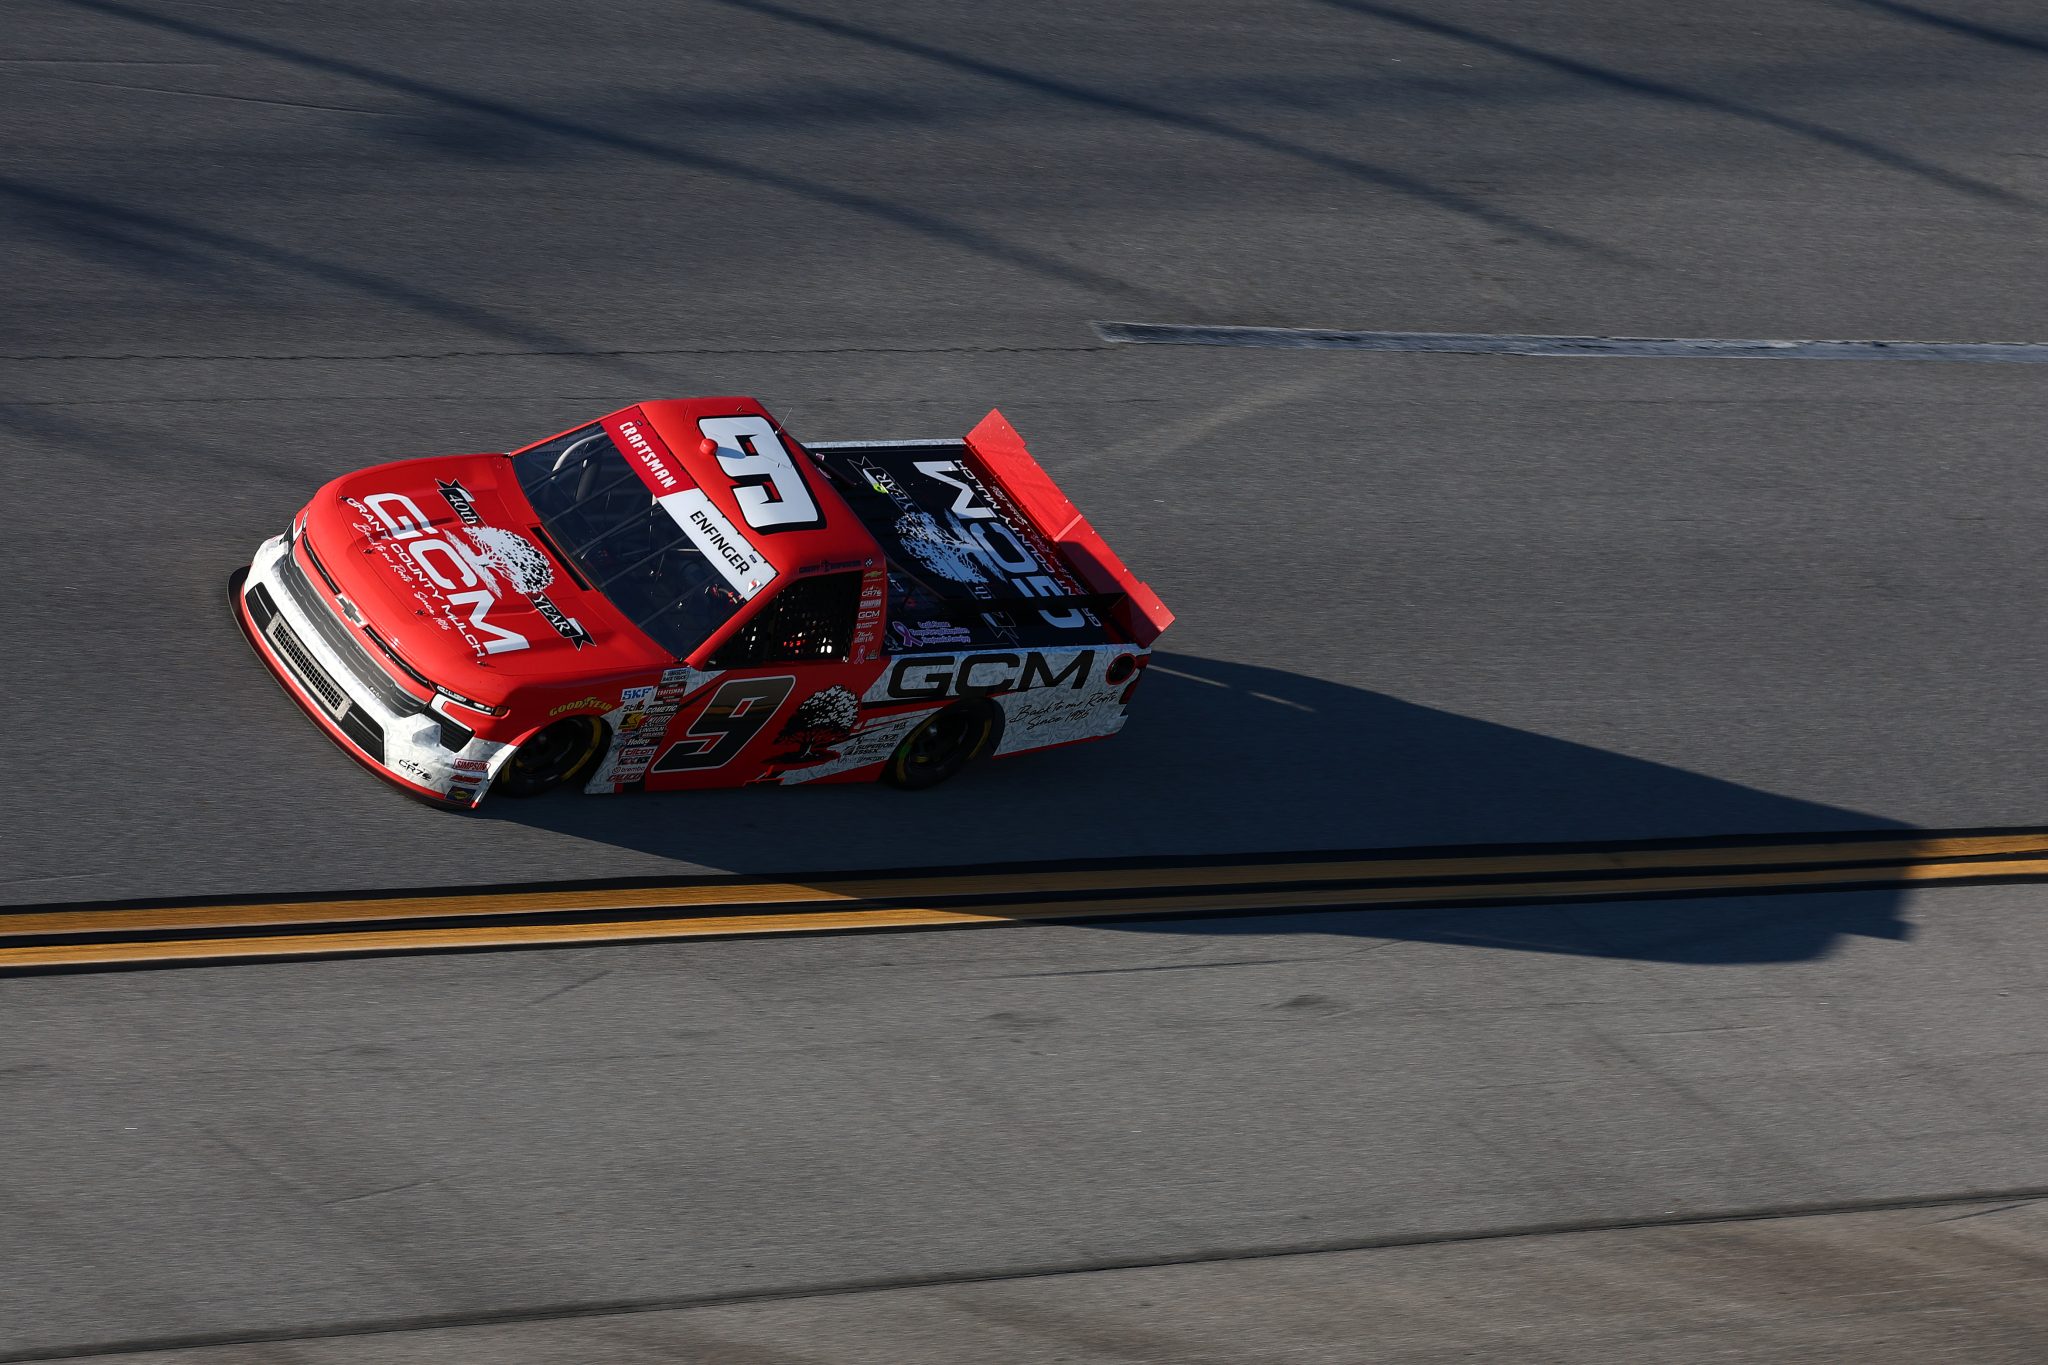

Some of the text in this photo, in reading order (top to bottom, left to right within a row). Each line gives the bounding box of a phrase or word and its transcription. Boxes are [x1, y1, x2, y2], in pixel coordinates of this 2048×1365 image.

[619, 421, 678, 489] CRAFTSMAN
[698, 415, 822, 532] 9
[450, 493, 479, 525] 40th
[690, 510, 751, 576] ENFINGER
[954, 459, 1103, 628] GRNT COUNTY MULCH
[346, 498, 487, 658] GRANT COUNTY MULCH
[363, 492, 531, 655] GCM
[390, 564, 413, 583] Roots
[414, 591, 435, 615] Since
[533, 594, 571, 637] YEAR
[858, 610, 881, 620] GCM
[622, 687, 652, 700] SKF
[887, 650, 1096, 698] GCM
[549, 696, 614, 717] GOODYEAR
[651, 674, 796, 773] 9
[1008, 703, 1053, 724] Back
[1050, 699, 1064, 712] to
[1084, 691, 1117, 708] Roots
[1026, 708, 1091, 731] Since 1986
[456, 760, 488, 771] SIMPSON
